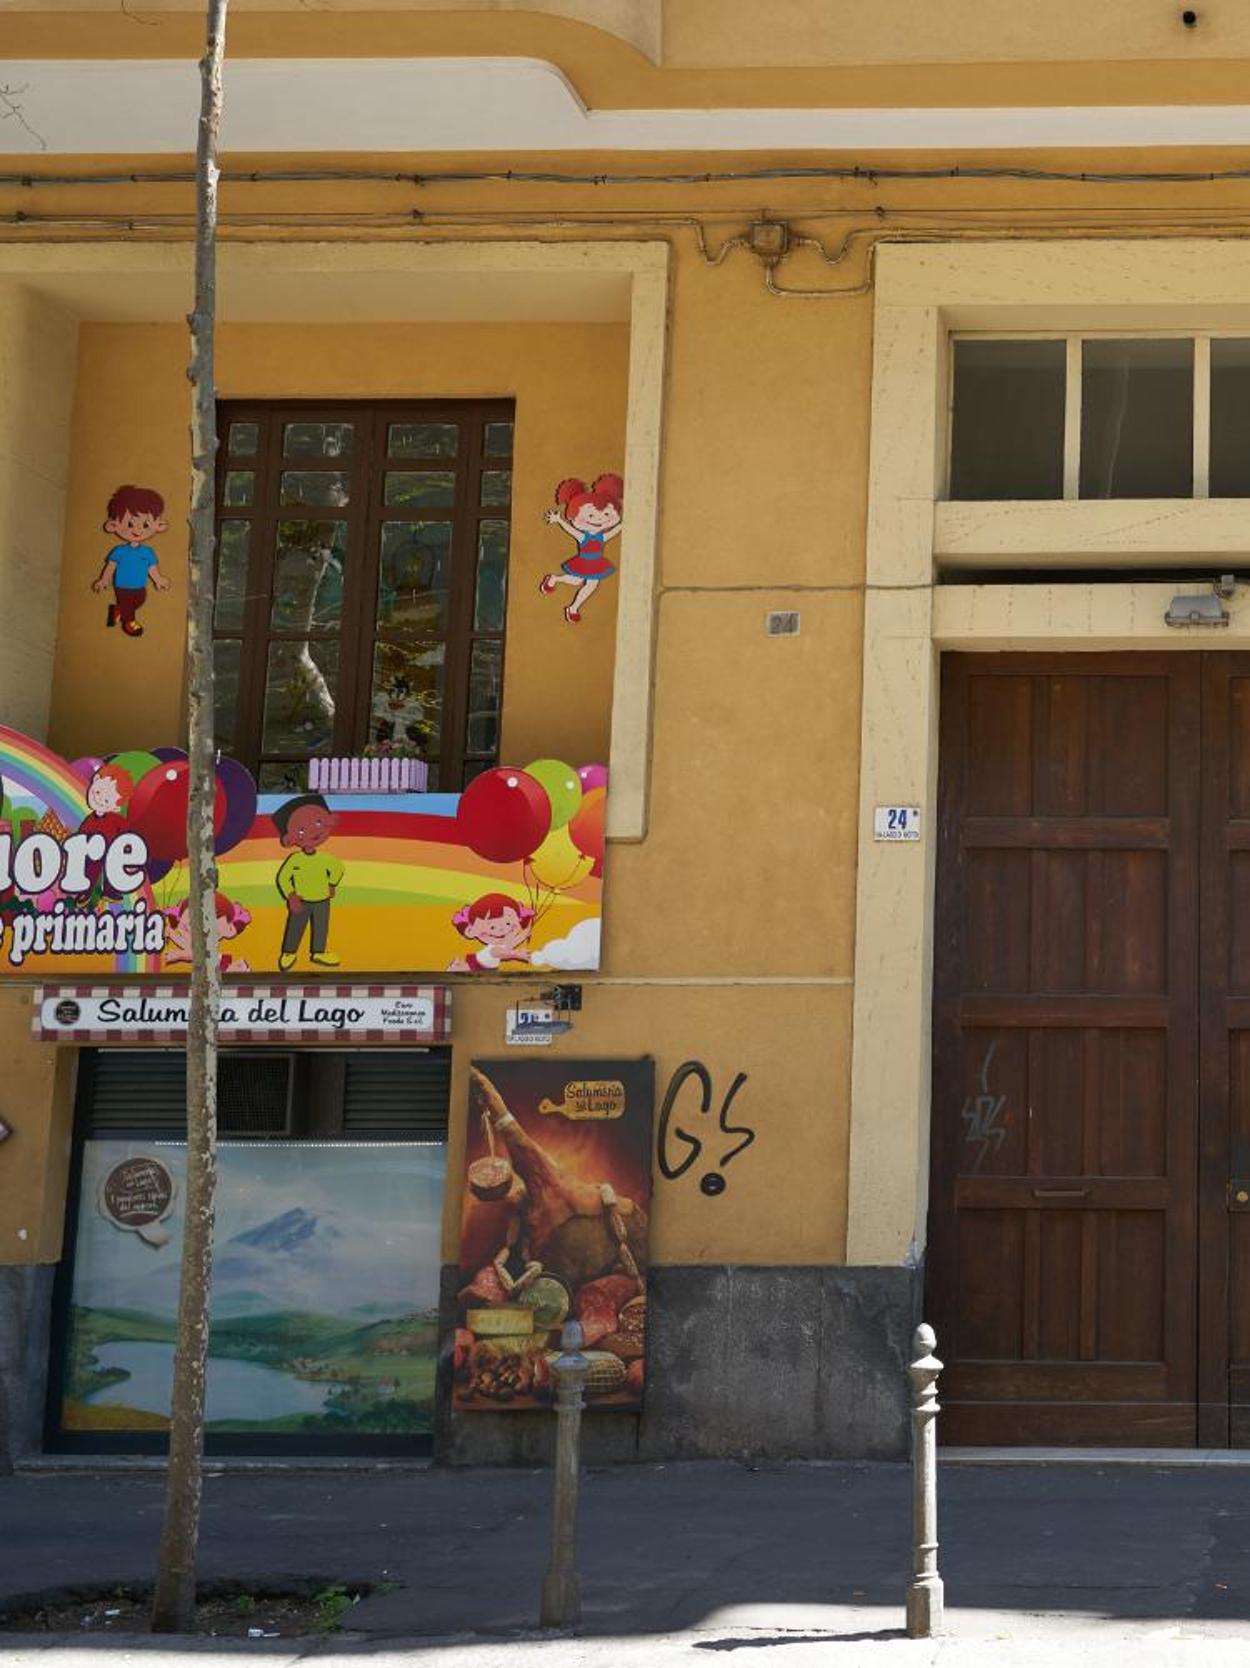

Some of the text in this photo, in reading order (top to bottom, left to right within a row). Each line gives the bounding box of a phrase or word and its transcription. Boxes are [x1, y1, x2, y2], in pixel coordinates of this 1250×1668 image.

[888, 809, 907, 830] 24
[10, 900, 165, 965] primaria
[248, 999, 291, 1023] del
[298, 1000, 364, 1029] Lago
[566, 1082, 621, 1099] Salumeria
[588, 1099, 616, 1115] Lago
